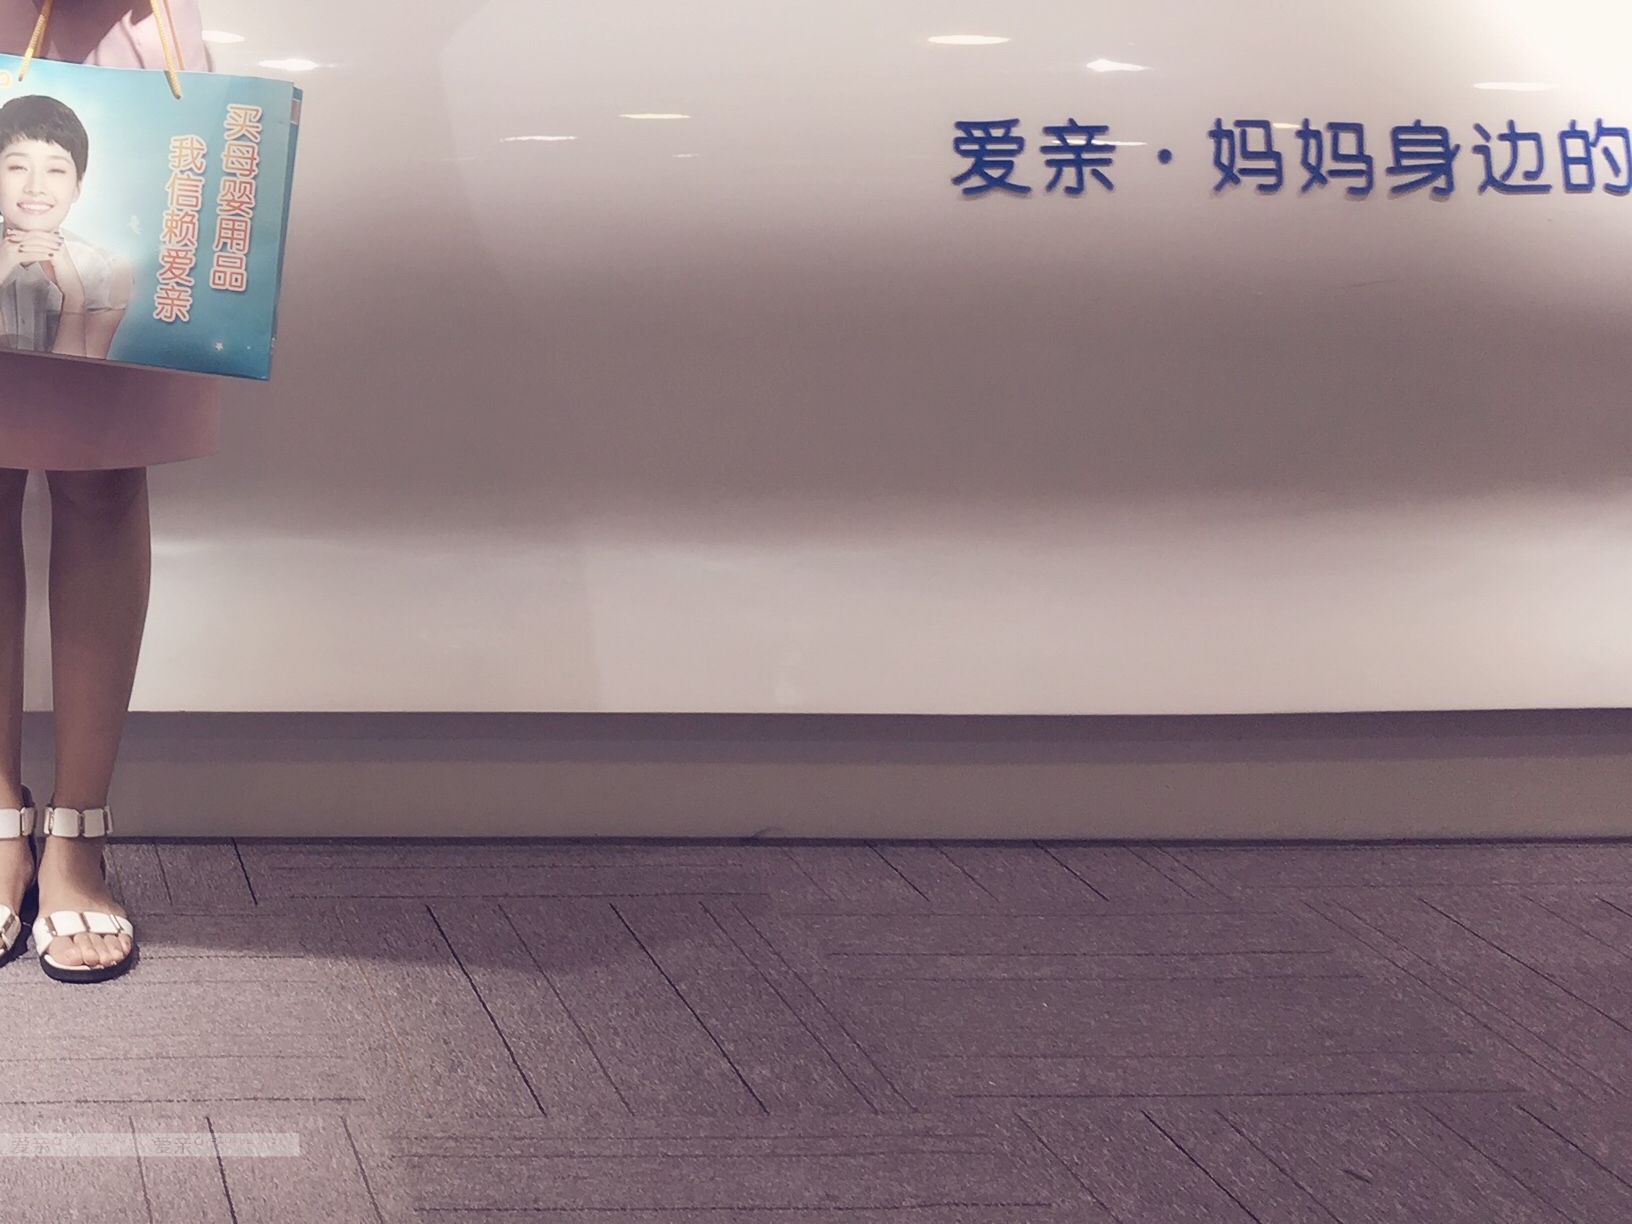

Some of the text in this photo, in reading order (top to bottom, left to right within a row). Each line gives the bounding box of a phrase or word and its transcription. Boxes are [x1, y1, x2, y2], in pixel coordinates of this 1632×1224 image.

[153, 134, 207, 322] 我信赖爱亲
[210, 103, 263, 292] 买母婴用品
